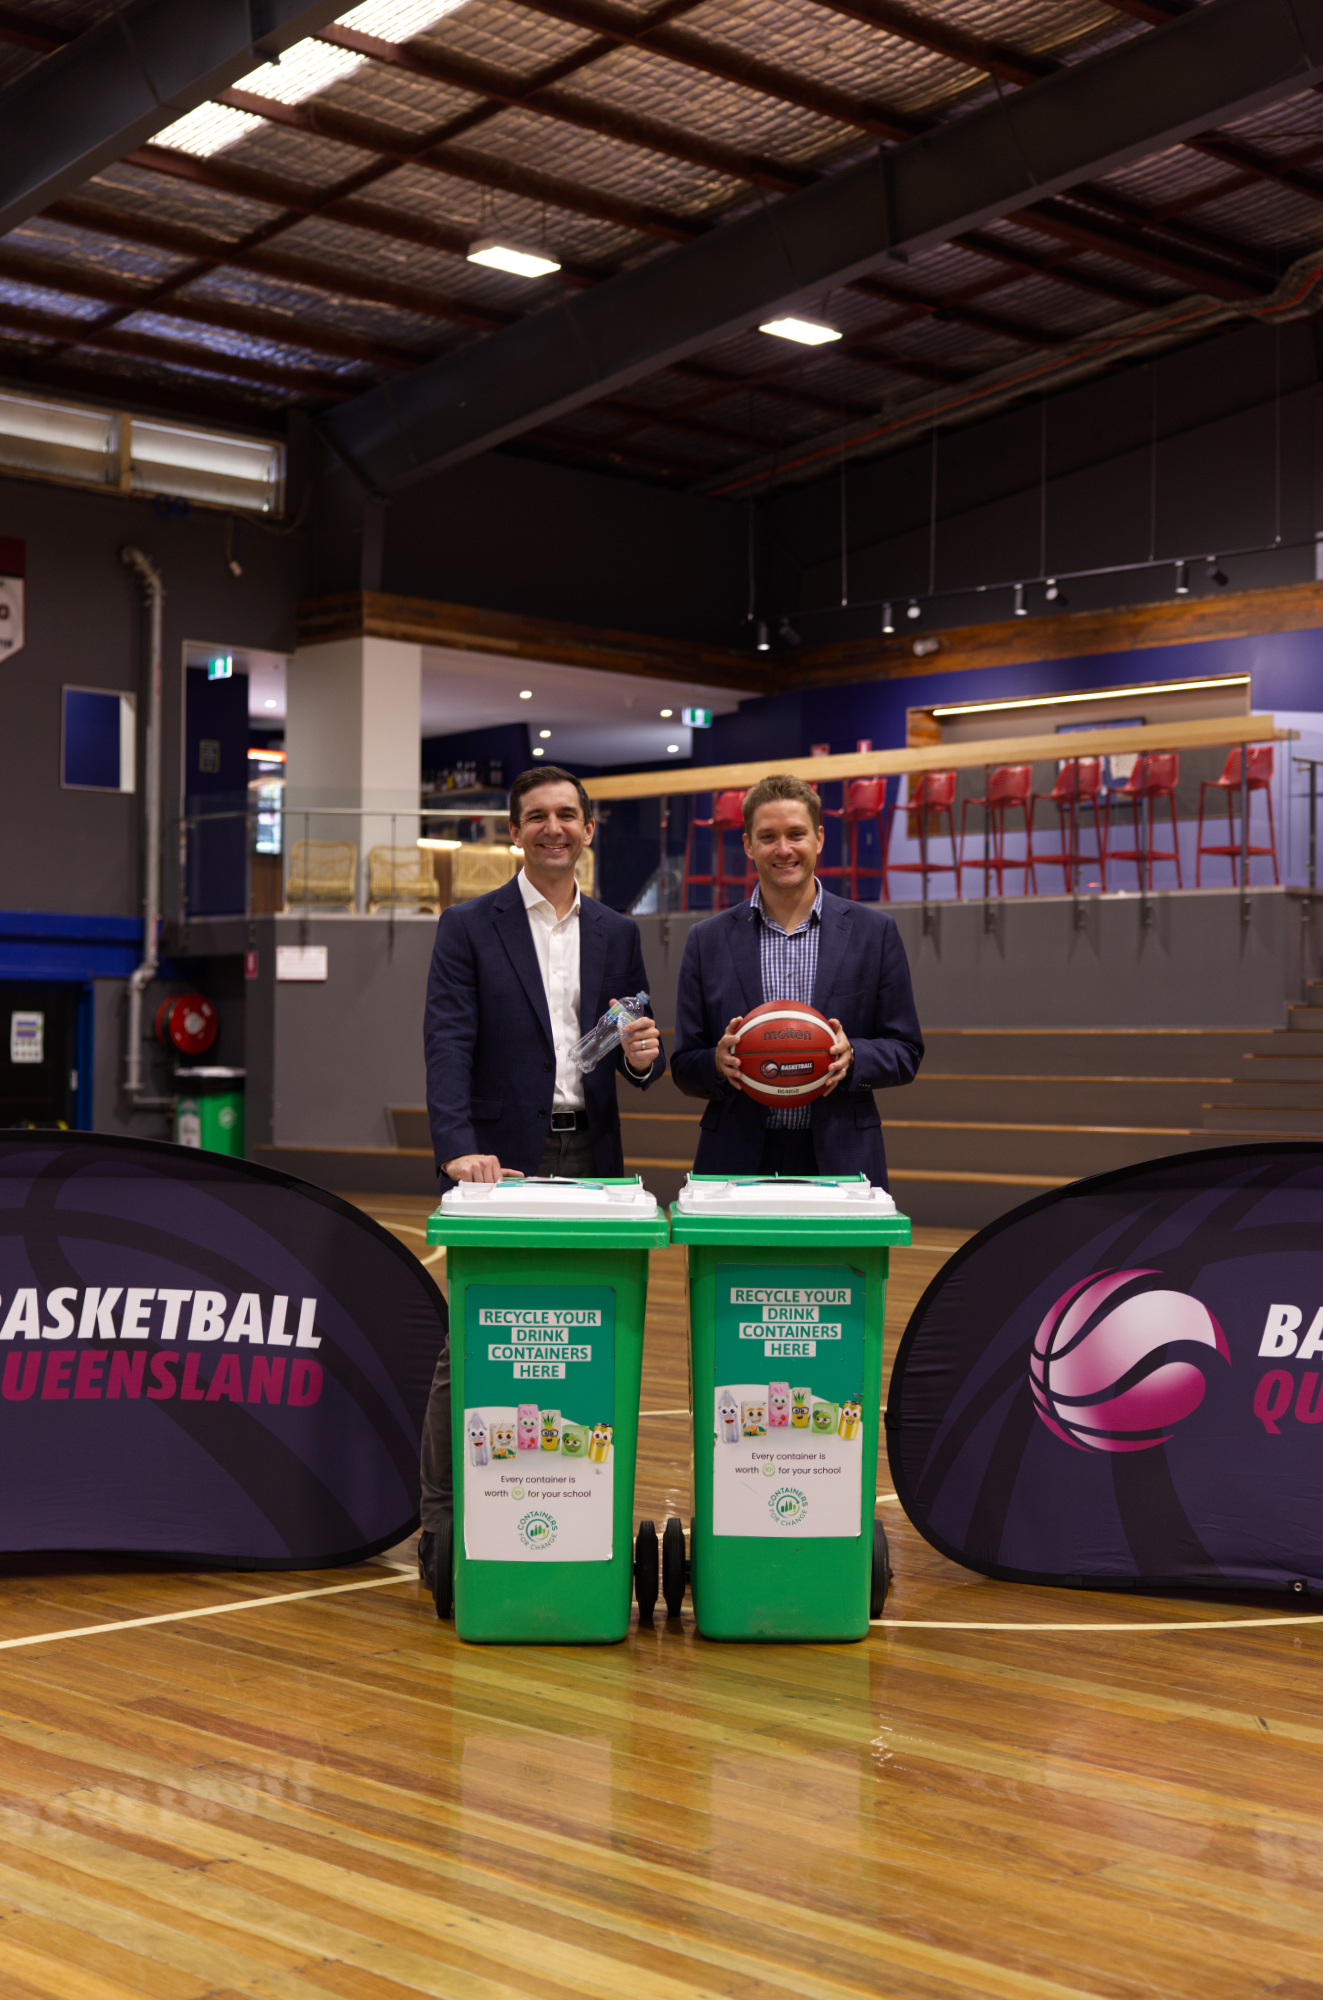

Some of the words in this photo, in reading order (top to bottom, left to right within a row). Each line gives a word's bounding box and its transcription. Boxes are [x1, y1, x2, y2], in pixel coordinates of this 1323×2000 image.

[764, 1028, 812, 1041] molten
[780, 1062, 813, 1071] BASKETBALL
[735, 1289, 800, 1303] RECYCLE
[804, 1290, 847, 1303] YOUR
[0, 1286, 323, 1349] ASKETBALL
[484, 1310, 549, 1324] RECYCLE
[553, 1311, 597, 1324] YOUR
[767, 1307, 816, 1321] DRINK
[517, 1329, 565, 1342] DRINK
[742, 1324, 839, 1338] CONTAINERS
[491, 1346, 588, 1360] CONTAINERS
[771, 1343, 810, 1355] HERE
[520, 1365, 559, 1378] HERE
[751, 1452, 775, 1461] Every
[776, 1452, 817, 1461] container
[819, 1452, 826, 1460] is
[735, 1466, 759, 1474] worth
[778, 1466, 790, 1474] for
[792, 1467, 811, 1476] your
[812, 1466, 841, 1474] school
[501, 1475, 524, 1485] Every
[525, 1476, 567, 1484] container
[484, 1489, 509, 1497] worth
[527, 1489, 540, 1497] for
[541, 1490, 561, 1499] your
[562, 1489, 592, 1498] school
[768, 1487, 809, 1507] CONTAINERS
[517, 1511, 558, 1531] CONTAINERS
[769, 1509, 780, 1523] FOR
[780, 1509, 808, 1526] CHANGE
[518, 1532, 530, 1547] FOR
[530, 1533, 557, 1550] CHANGE
